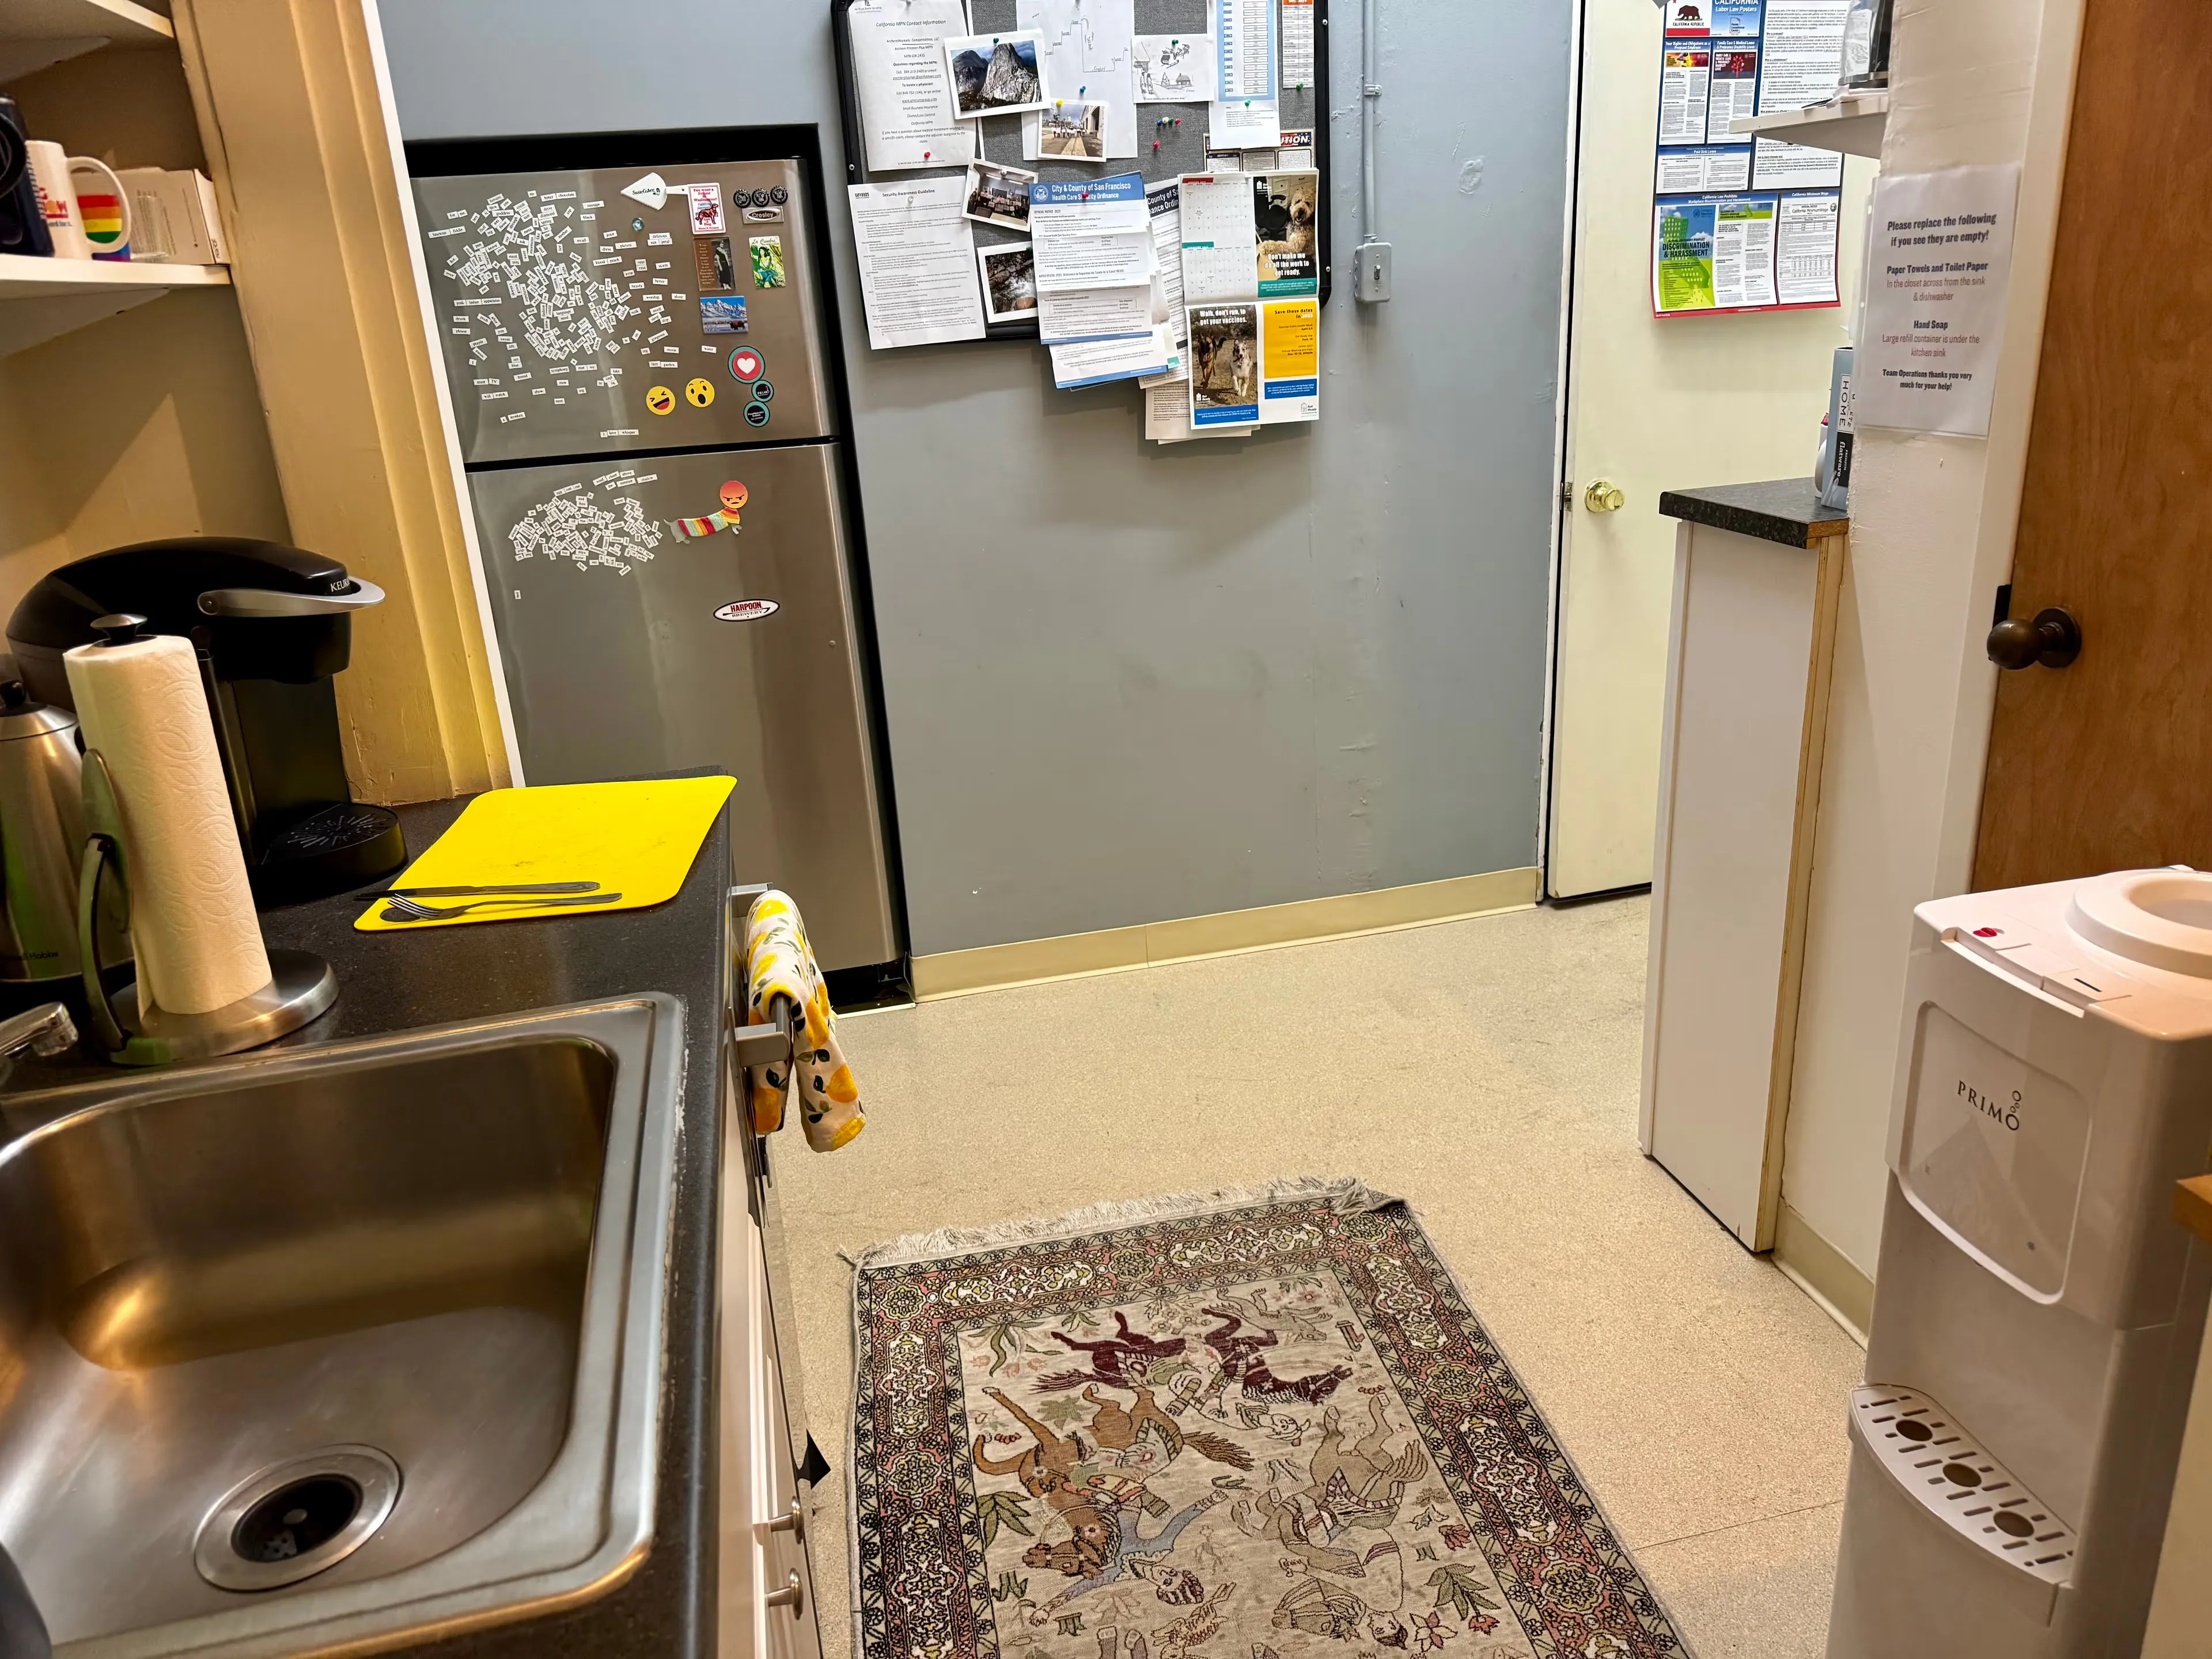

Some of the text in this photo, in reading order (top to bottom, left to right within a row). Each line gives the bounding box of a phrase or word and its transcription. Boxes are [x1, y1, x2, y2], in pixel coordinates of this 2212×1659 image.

[1052, 185, 1062, 193] City
[1069, 184, 1086, 192] County
[1147, 194, 1165, 204] County
[1166, 190, 1172, 198] of
[1165, 199, 1179, 209] Ordin
[1888, 213, 1997, 230] Please replace the following
[1891, 237, 1897, 246] if
[1899, 238, 1911, 248] you
[1927, 234, 1944, 245] they
[1960, 230, 1989, 243] empty!
[1663, 242, 1709, 250] DISCRIMINATION
[1671, 249, 1707, 257] HARASSMENT
[1887, 262, 1988, 275] Paper Towels and Toilet Paper
[1887, 280, 1892, 288] In
[1894, 279, 1903, 287] the
[1904, 279, 1922, 287] closet
[1923, 279, 1942, 287] across
[1944, 278, 1959, 286] from
[1972, 276, 1985, 285] sink
[1919, 292, 1954, 301] dishwasher
[1931, 320, 1948, 330] Soap
[1883, 335, 1899, 344] Large
[1900, 334, 1912, 342] refill
[1949, 335, 1968, 343] under
[1969, 335, 1979, 343] the
[1911, 347, 1946, 357] kitchen sink
[1899, 370, 1927, 378] Operations
[1938, 383, 1952, 391] help!
[1839, 381, 1849, 426] HOME
[1837, 442, 1845, 477] flatware
[730, 601, 762, 612] HARPOON
[1957, 1080, 2019, 1130] PRIMO
